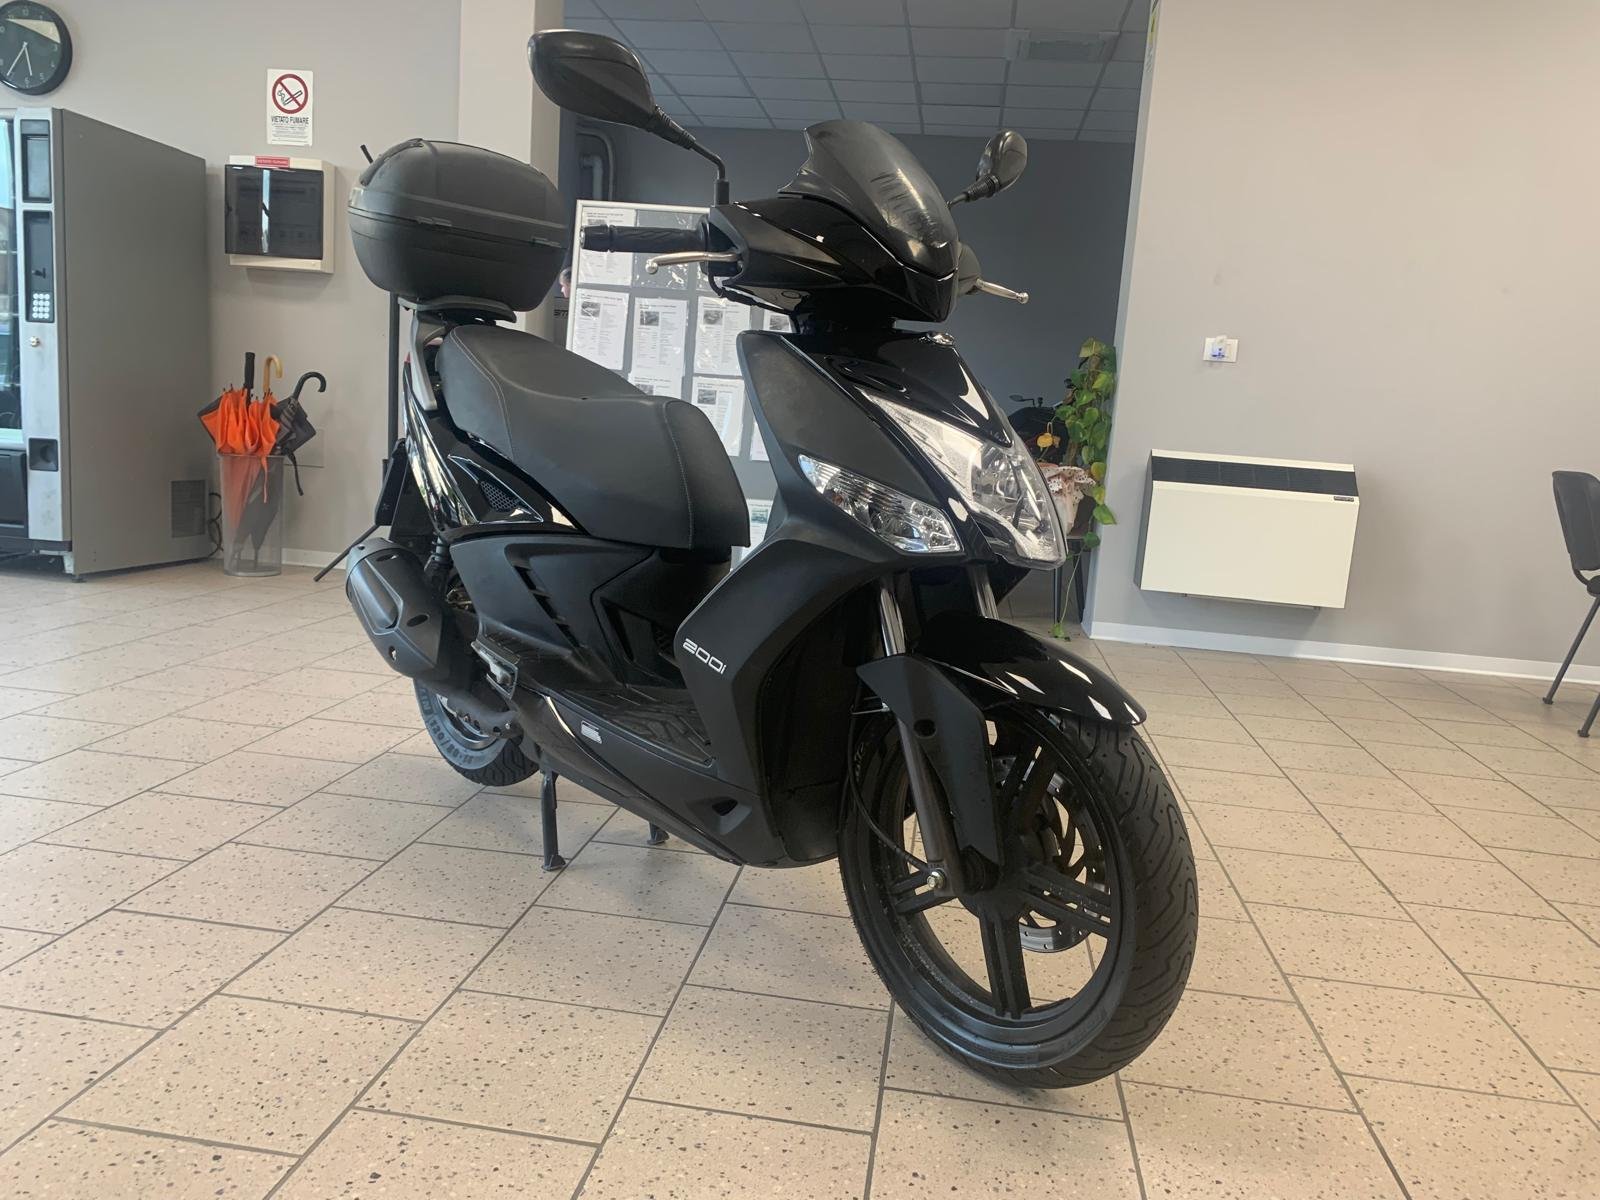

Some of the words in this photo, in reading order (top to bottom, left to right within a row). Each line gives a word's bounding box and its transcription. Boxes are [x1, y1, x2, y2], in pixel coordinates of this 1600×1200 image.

[271, 115, 289, 124] VIETATO
[289, 116, 310, 125] FUMARE
[682, 637, 727, 675] 200i
